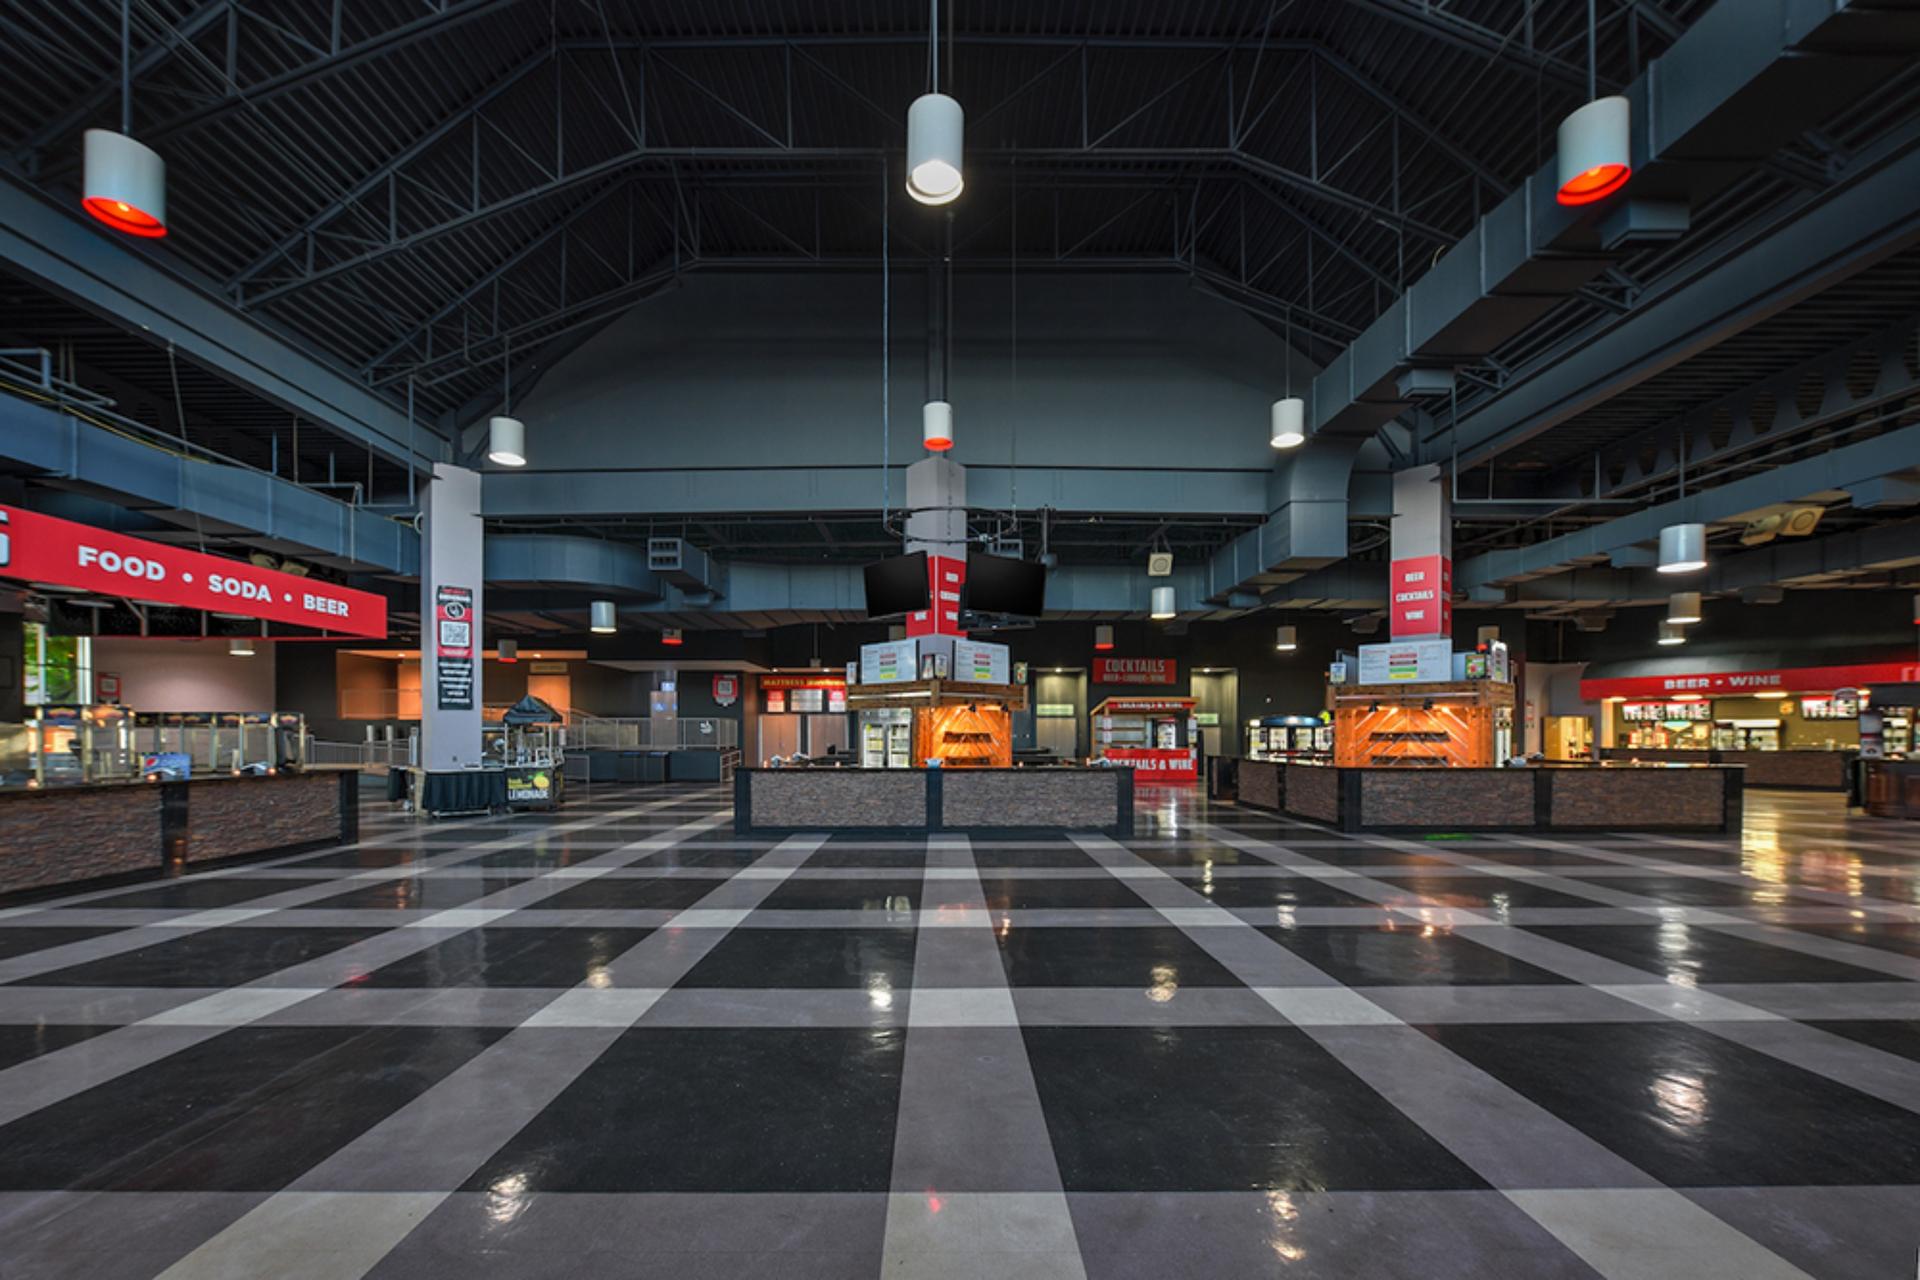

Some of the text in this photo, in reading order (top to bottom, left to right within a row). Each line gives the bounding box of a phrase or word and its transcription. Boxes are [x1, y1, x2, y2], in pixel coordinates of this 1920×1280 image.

[77, 545, 349, 618] FOOD SODA BEER
[1105, 658, 1165, 673] COCKTAILS
[1664, 675, 1781, 690] BEER WINE
